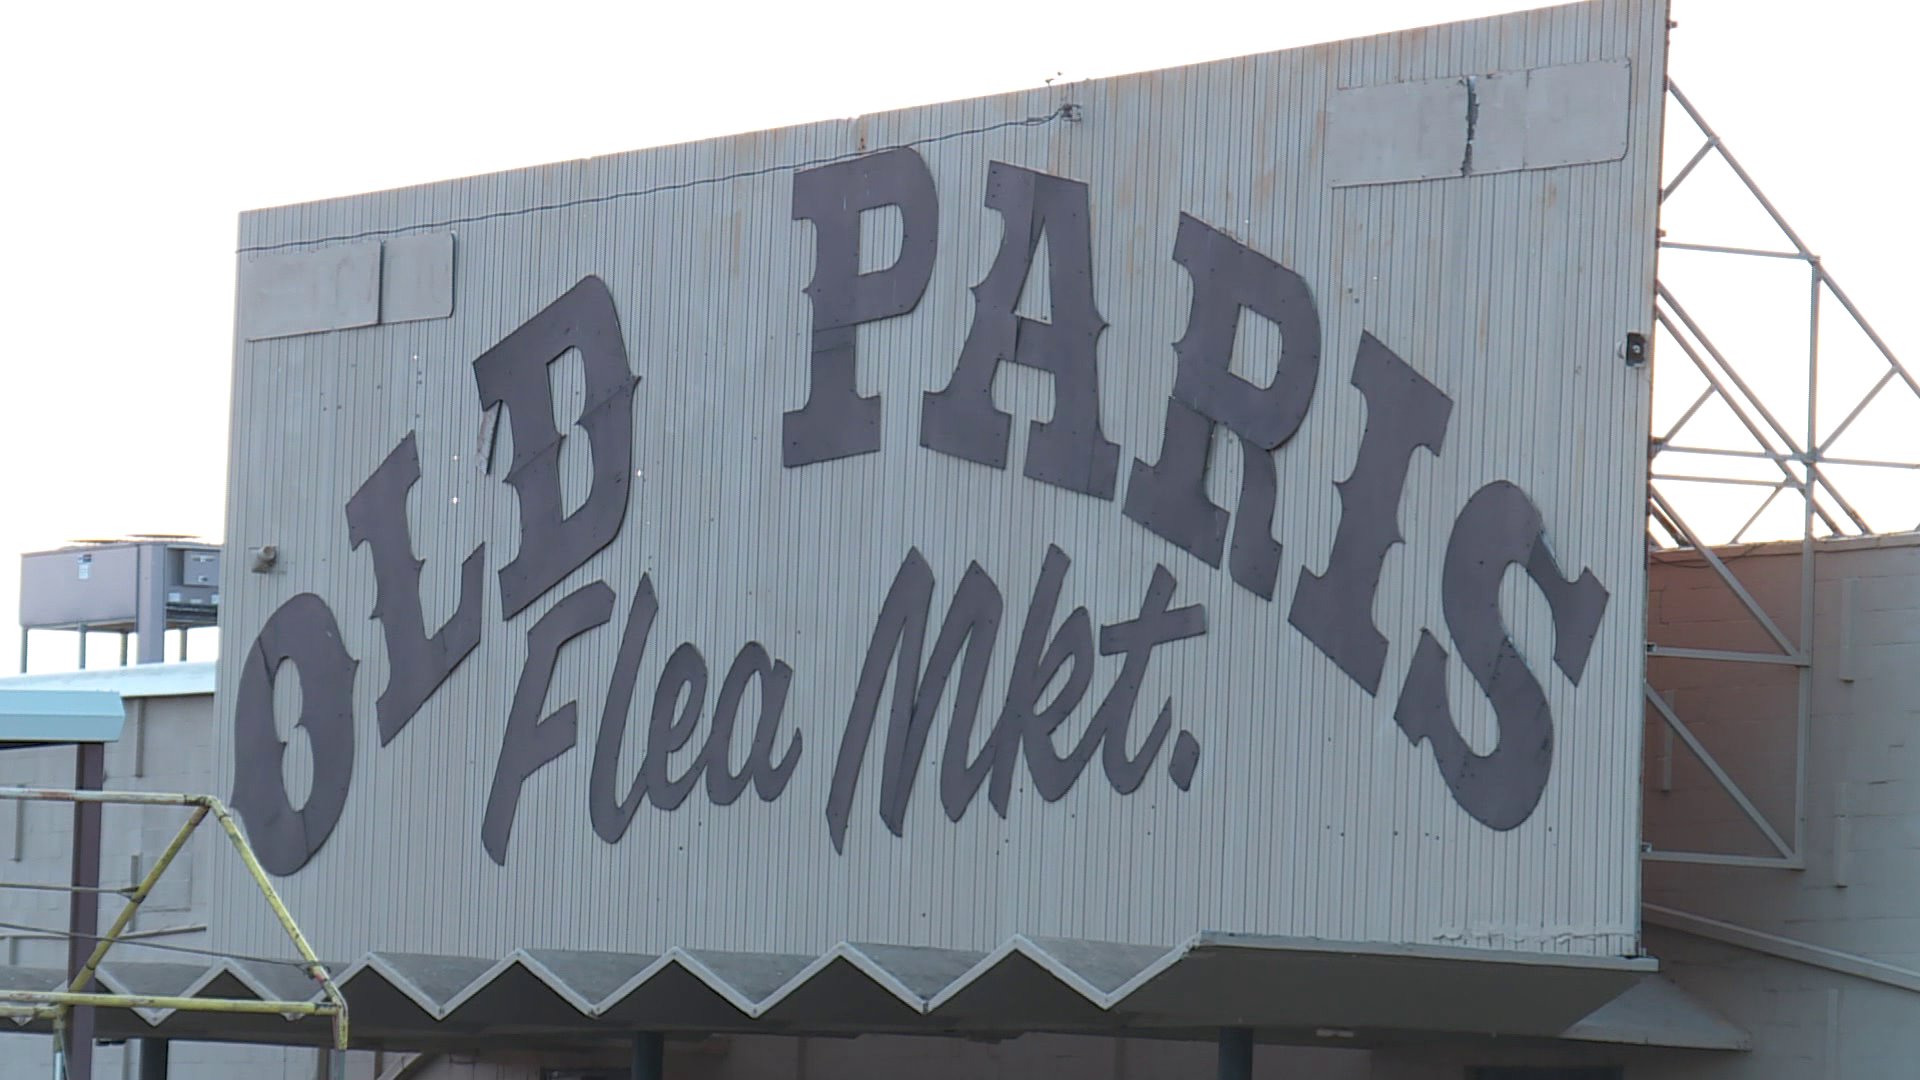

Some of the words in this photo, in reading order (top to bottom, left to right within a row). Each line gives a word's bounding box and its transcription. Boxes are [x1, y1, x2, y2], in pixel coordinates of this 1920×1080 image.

[232, 275, 642, 877] OLD
[784, 147, 1607, 832] PARIS
[482, 572, 802, 866] Flea
[827, 543, 1208, 856] Mkt.
